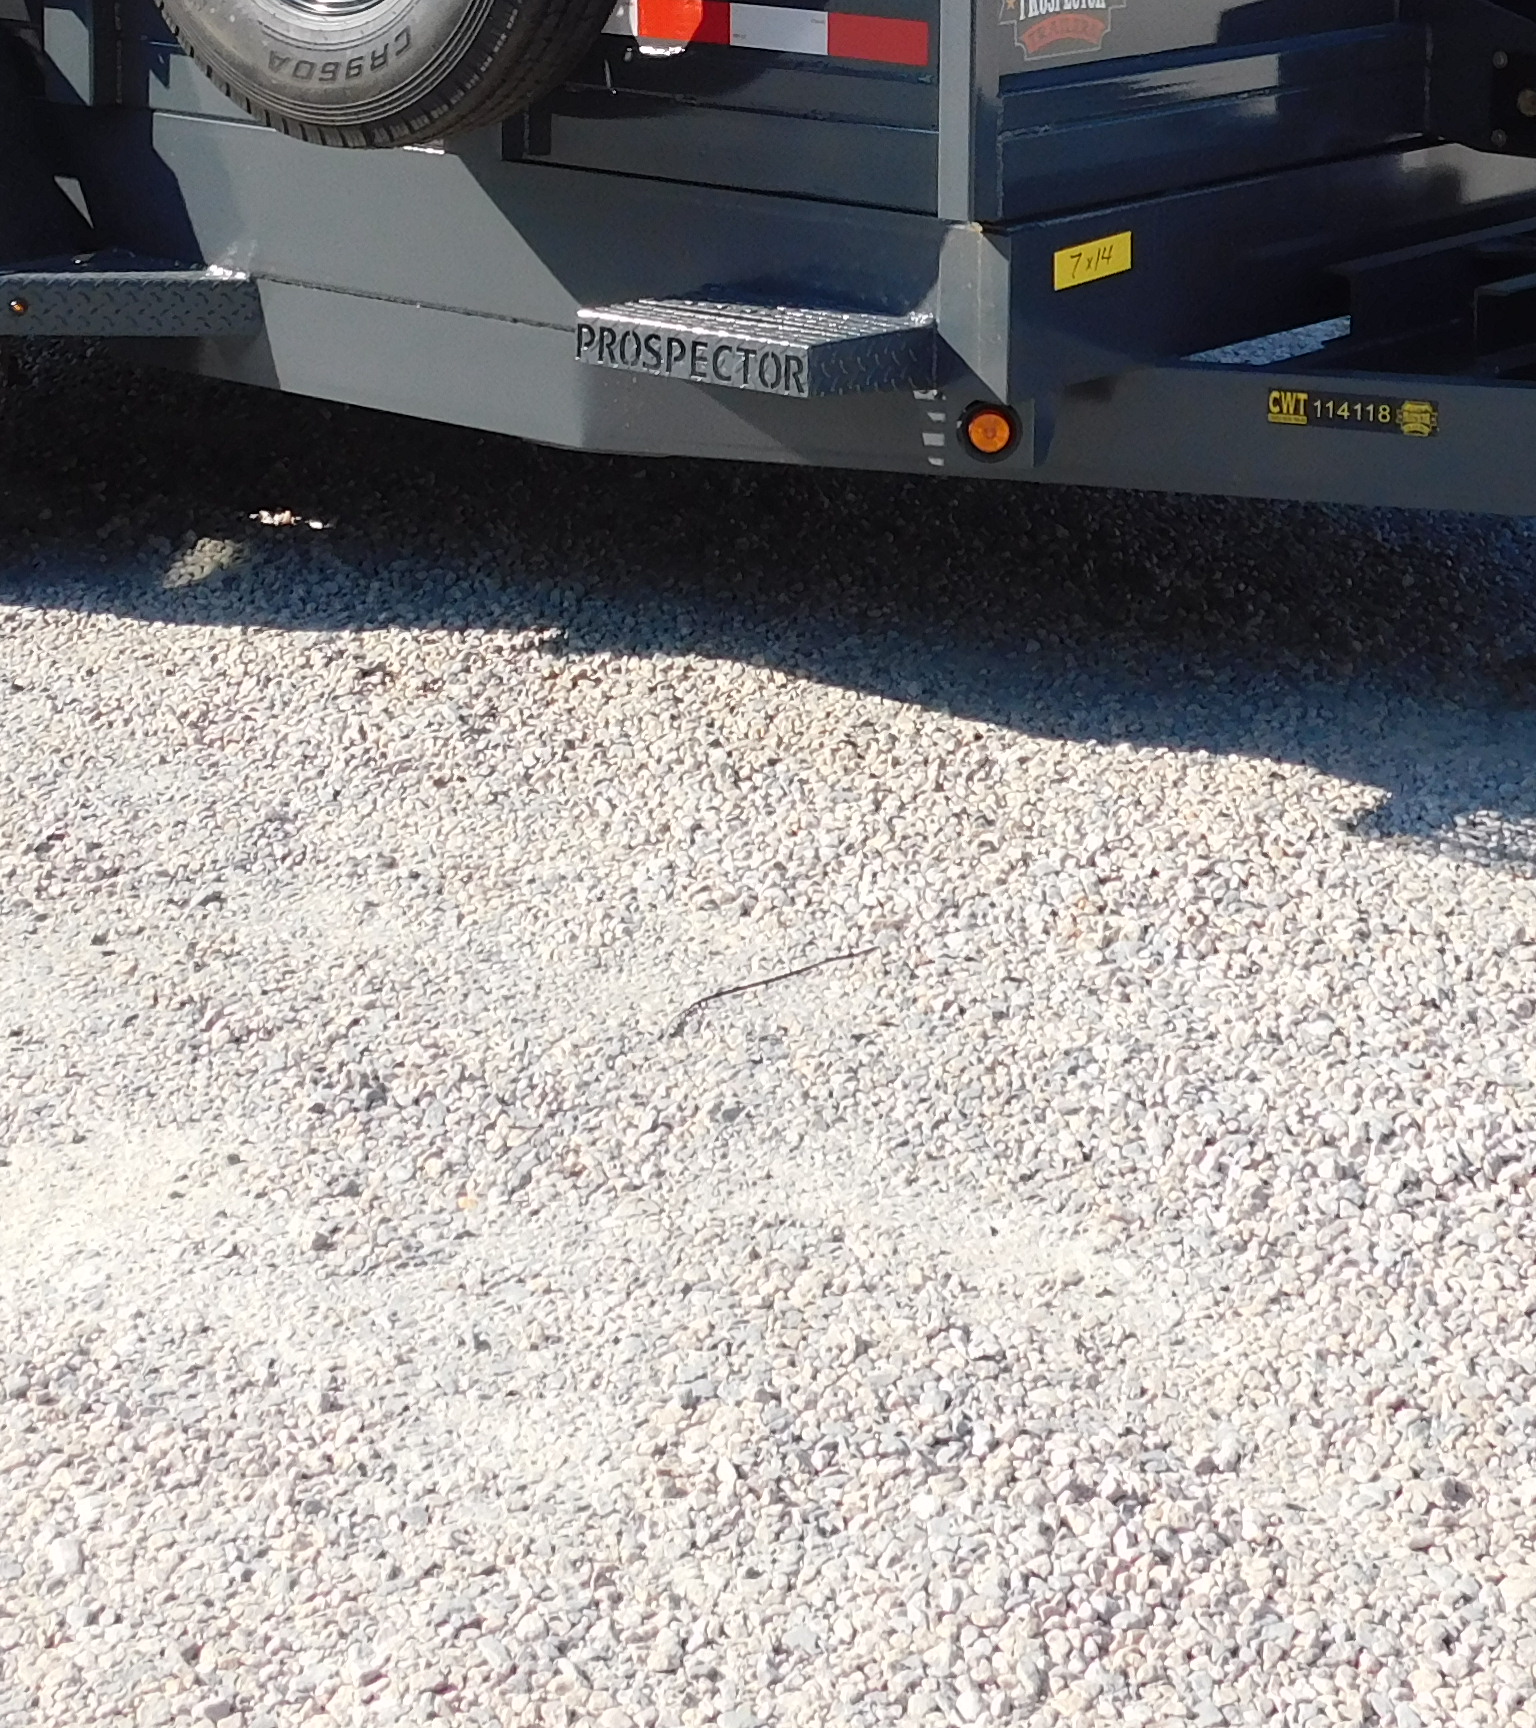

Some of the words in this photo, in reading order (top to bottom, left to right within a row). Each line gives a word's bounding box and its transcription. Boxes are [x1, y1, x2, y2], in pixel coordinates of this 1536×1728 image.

[267, 24, 412, 82] CR960A
[575, 322, 807, 395] PROSPECTOR
[1268, 389, 1309, 416] CWT
[1312, 399, 1392, 424] 114118
